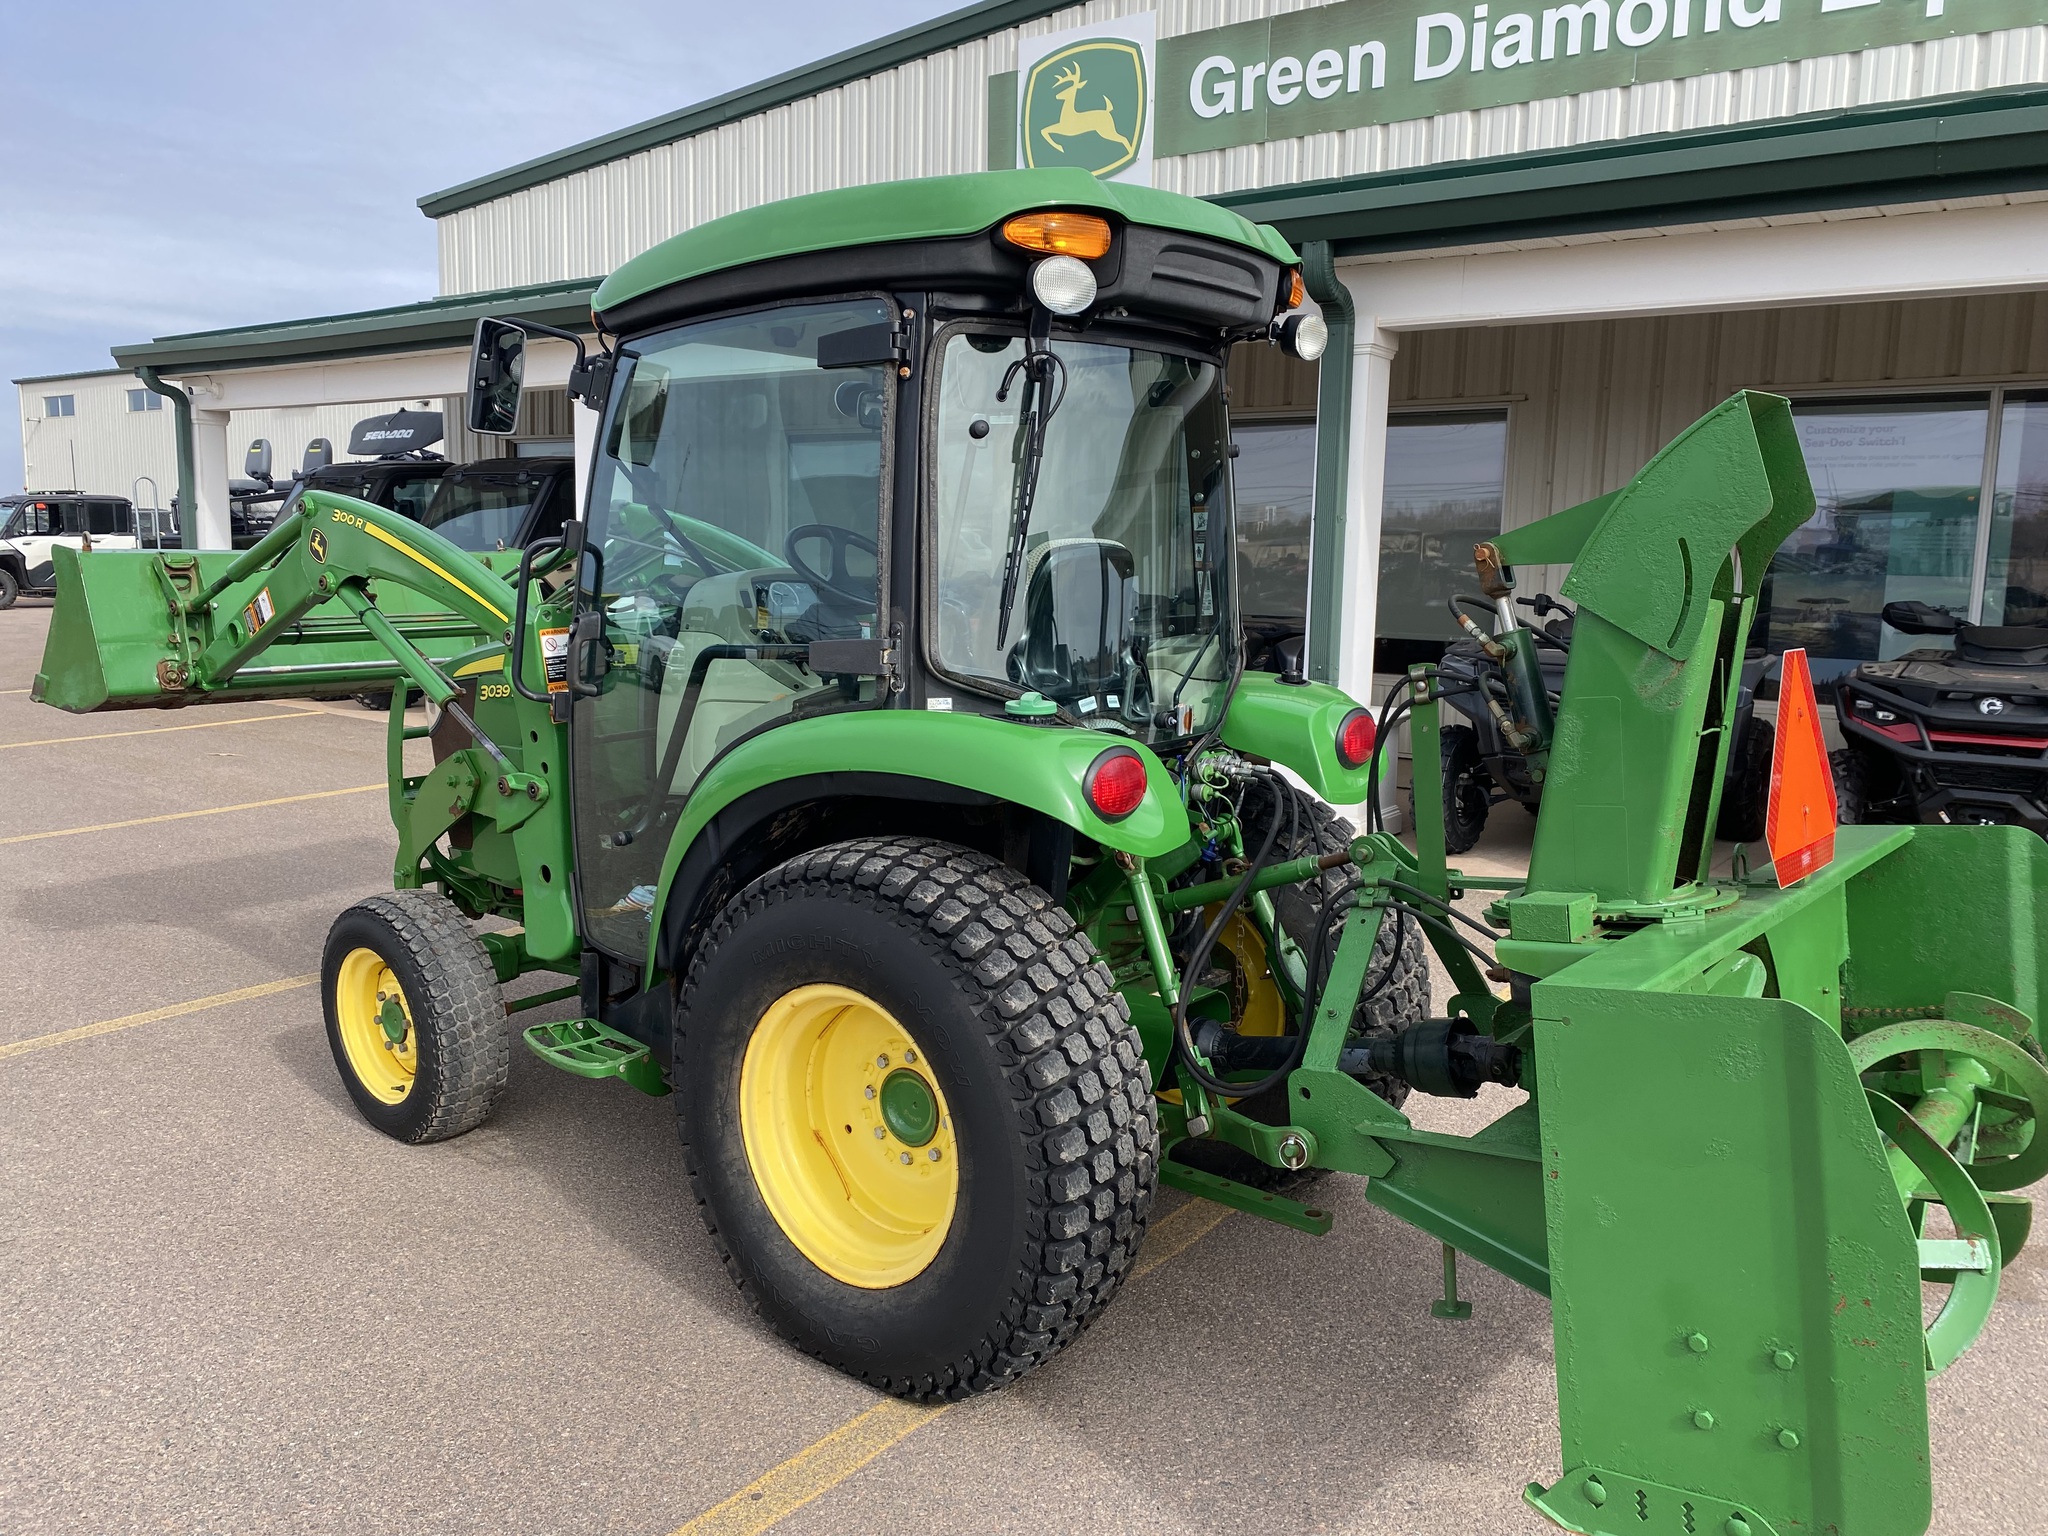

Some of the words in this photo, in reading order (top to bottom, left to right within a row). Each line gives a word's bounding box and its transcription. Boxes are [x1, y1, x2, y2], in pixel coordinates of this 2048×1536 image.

[1189, 40, 1387, 119] Green
[1805, 424, 1866, 435] Customize
[1868, 425, 1897, 436] your
[331, 508, 355, 526] 300
[355, 517, 364, 529] R
[480, 684, 513, 701] 3039
[751, 933, 885, 970] MIGHTY
[908, 988, 973, 1087] MOW
[728, 1234, 882, 1353] GALAXY
